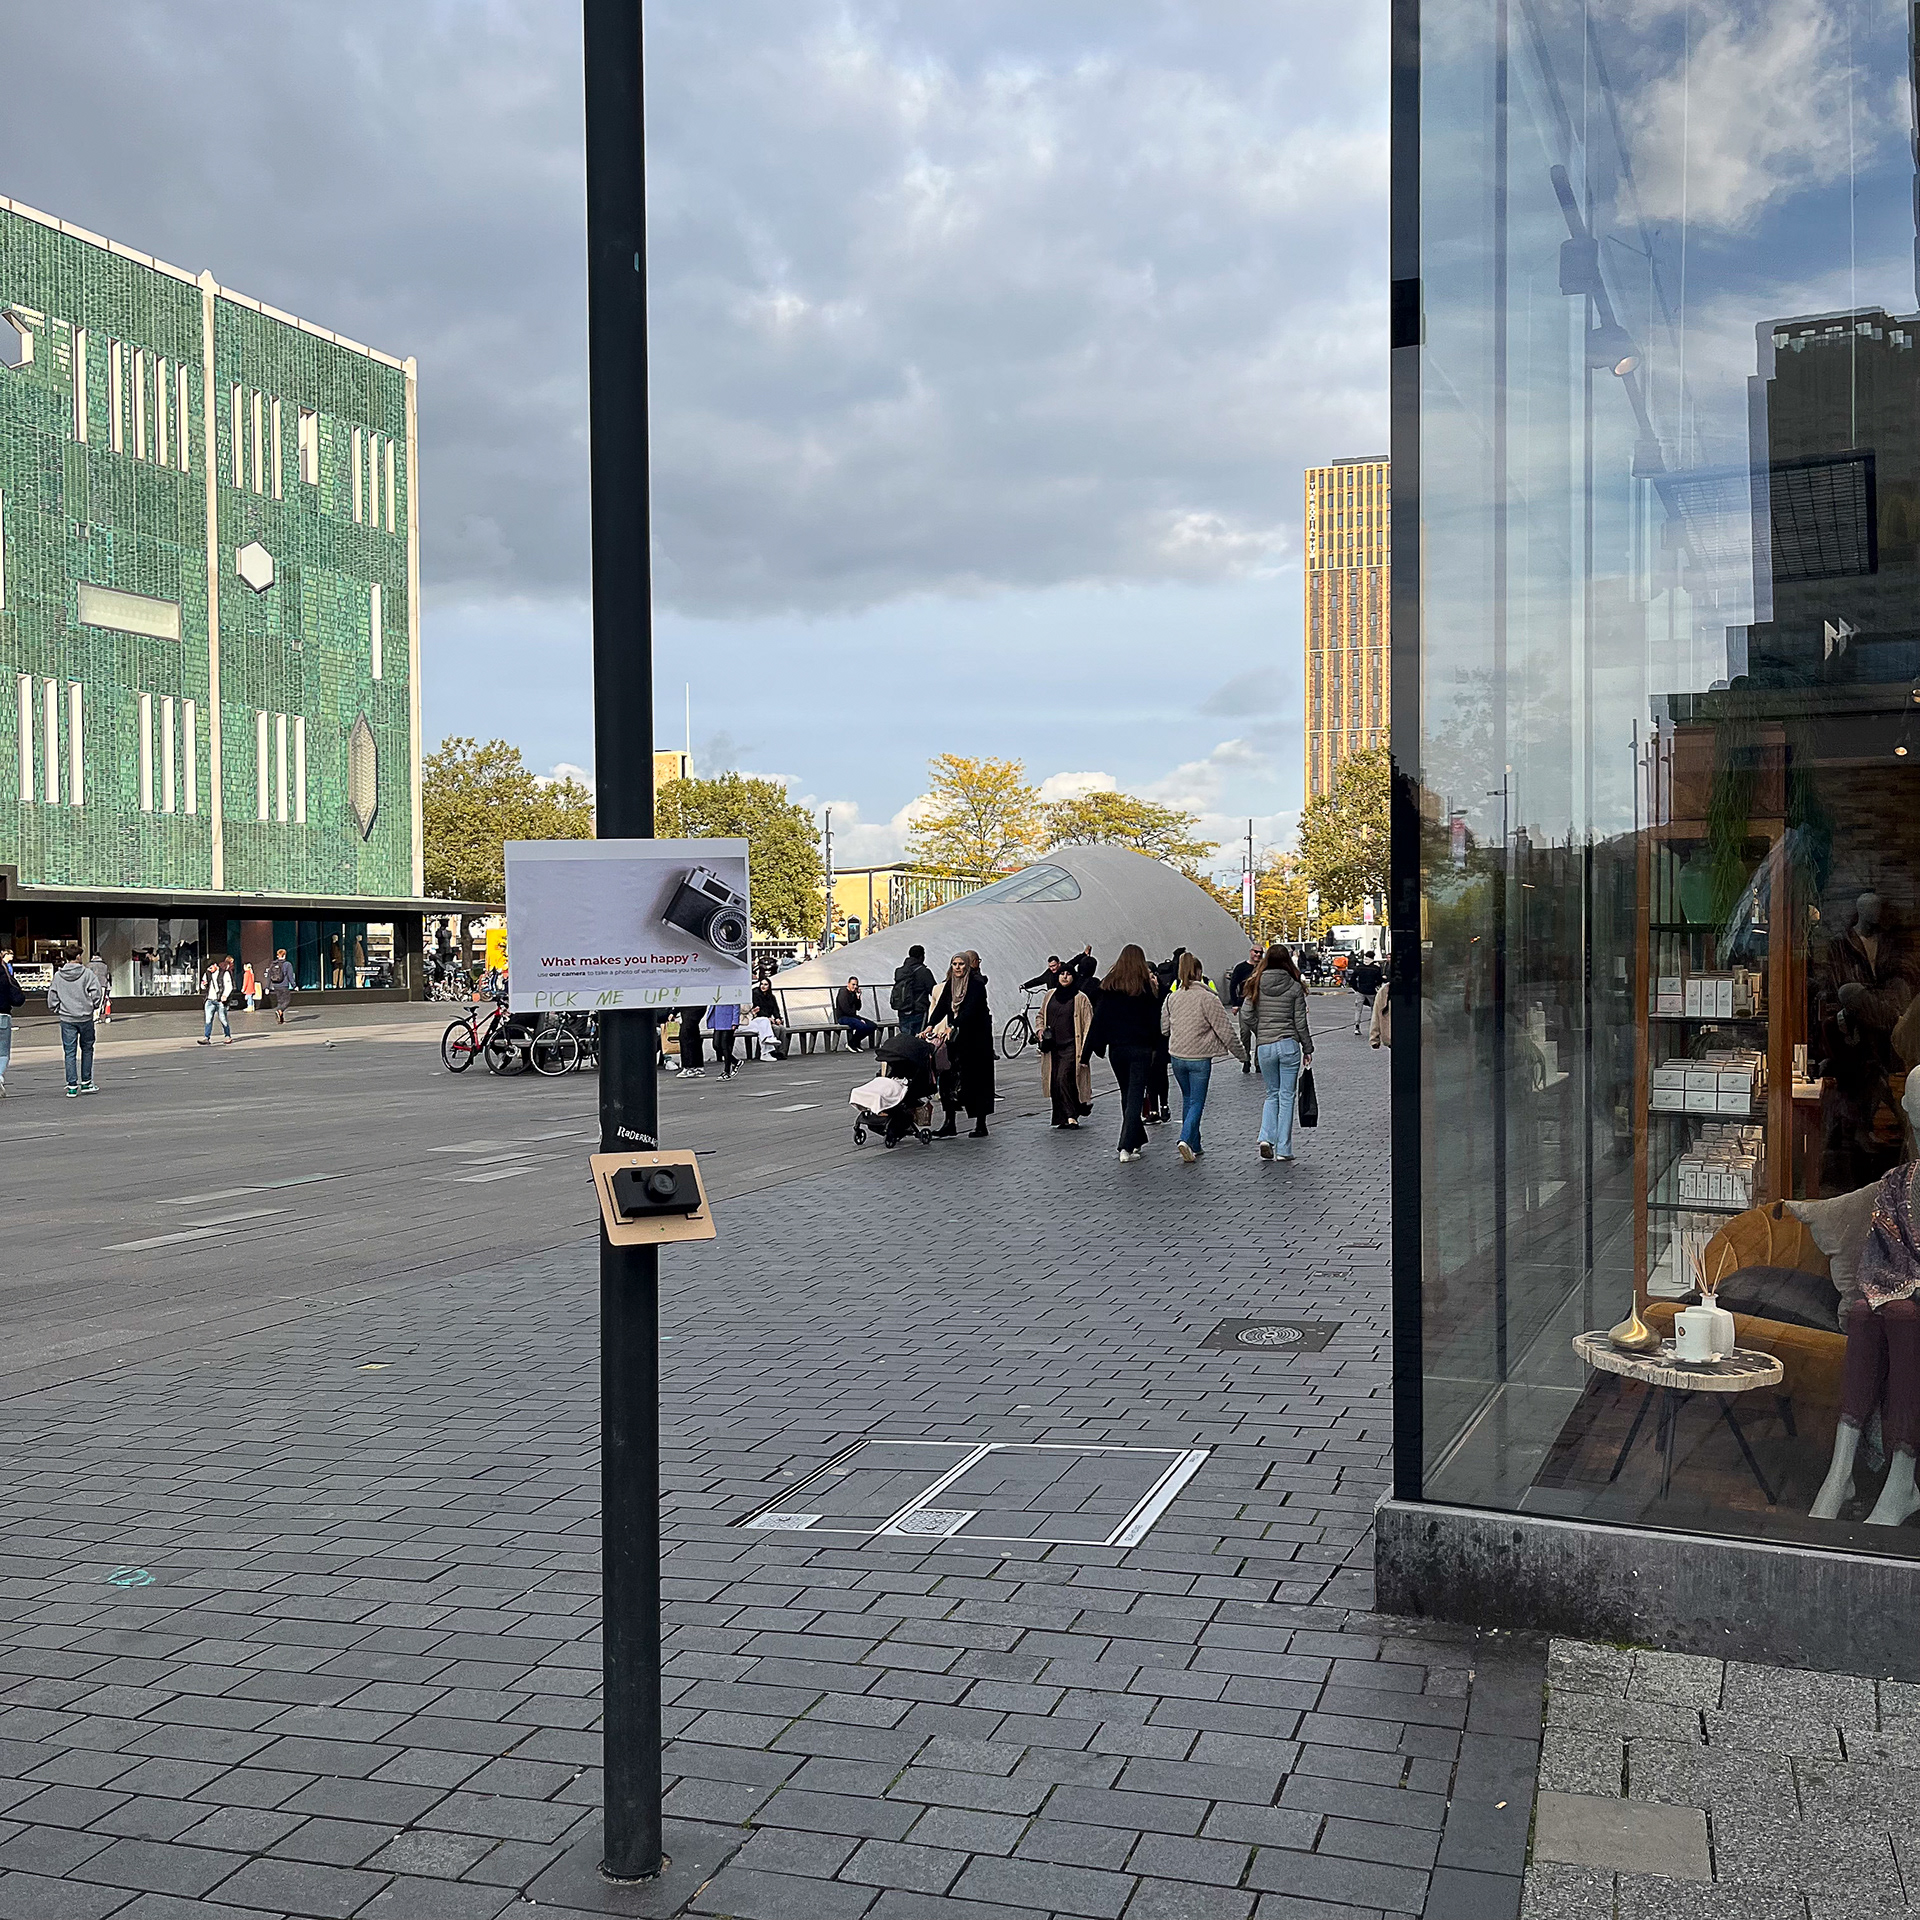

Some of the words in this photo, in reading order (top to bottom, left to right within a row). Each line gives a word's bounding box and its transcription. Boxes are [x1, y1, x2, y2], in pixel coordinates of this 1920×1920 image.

[541, 956, 576, 967] What
[580, 955, 621, 966] makes
[624, 956, 647, 967] you
[650, 953, 689, 965] happy
[691, 952, 699, 962] ?
[535, 990, 579, 1008] PICK
[596, 990, 624, 1006] ME
[644, 986, 681, 1004] UP!
